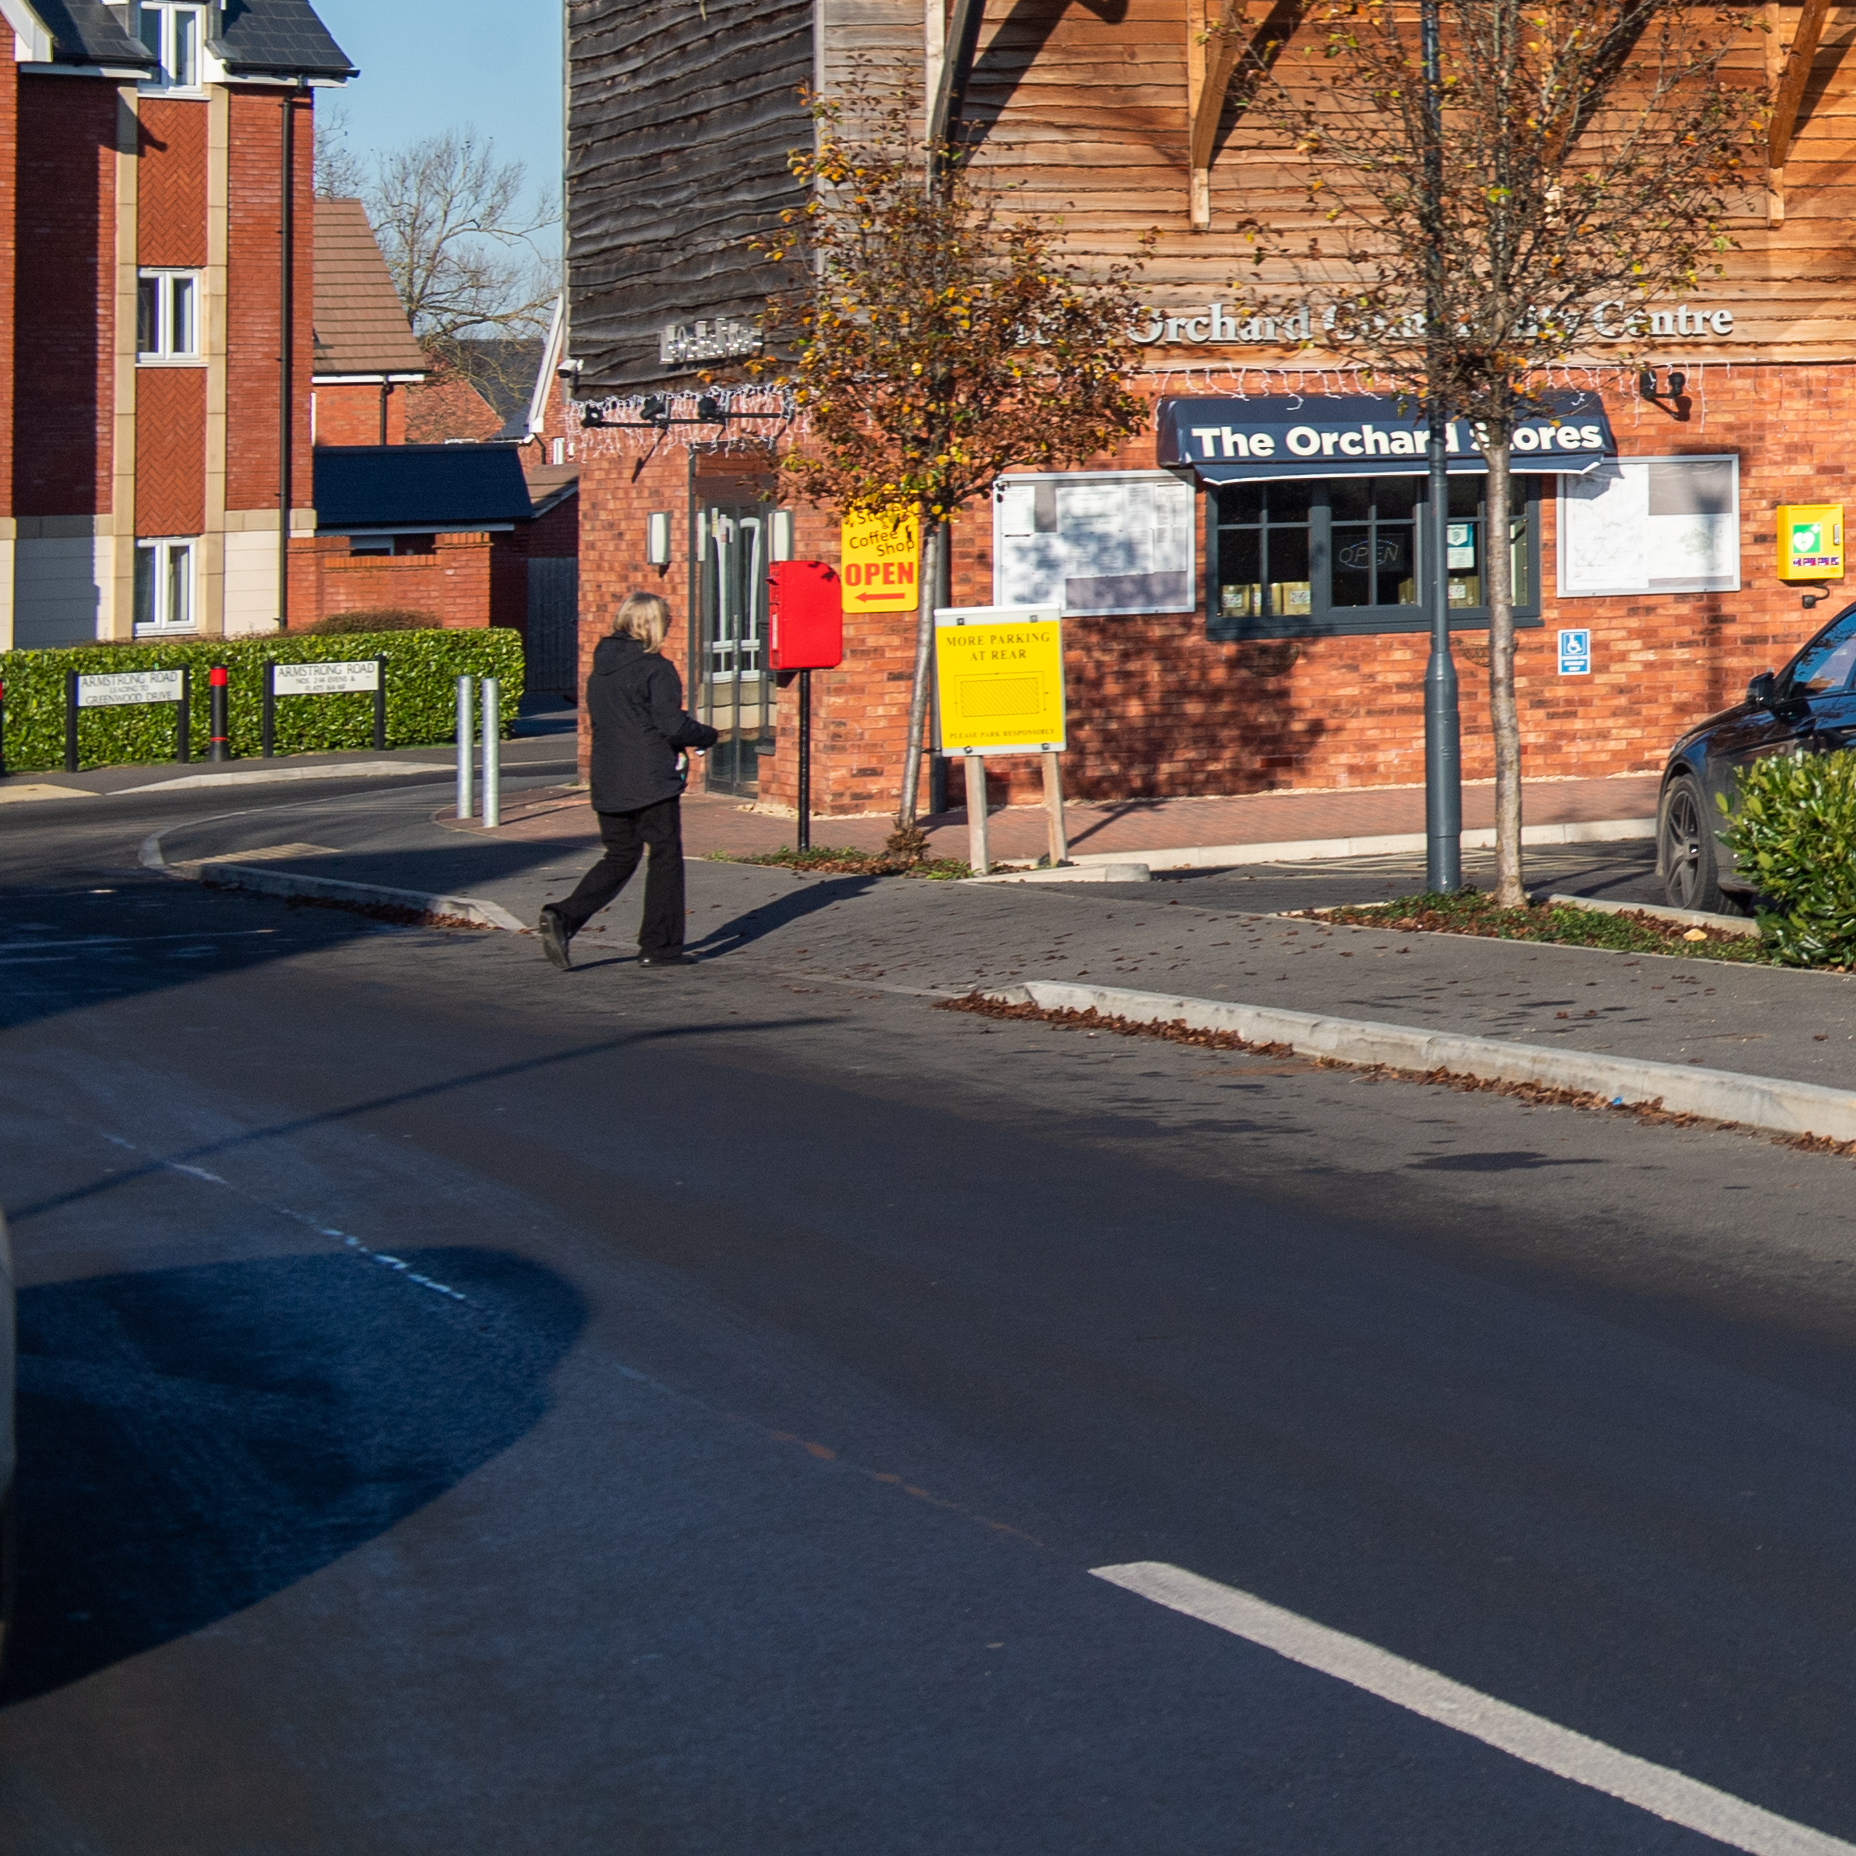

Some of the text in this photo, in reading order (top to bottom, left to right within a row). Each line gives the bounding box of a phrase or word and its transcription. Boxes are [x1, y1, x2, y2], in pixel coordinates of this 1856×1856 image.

[1127, 302, 1313, 343] Orchard
[1322, 302, 1581, 342] Comity
[1591, 300, 1733, 339] Centre
[1191, 425, 1275, 458] The
[1469, 422, 1603, 451] Sores
[849, 529, 898, 550] Coffee
[876, 540, 915, 557] Shop
[1338, 545, 1399, 564] OPEN
[844, 561, 915, 587] OPEN
[946, 632, 1050, 647] MORE PARKING
[970, 649, 1027, 662] AT REAR
[278, 663, 375, 677] ARMSTRONG ROAD
[81, 671, 178, 687] ARMSTRONG ROAD
[109, 684, 149, 693] LEADING TO
[86, 690, 172, 705] GREENWOOD DRIVE
[949, 728, 1055, 740] PLEASE PARK RESPONSIBLY
